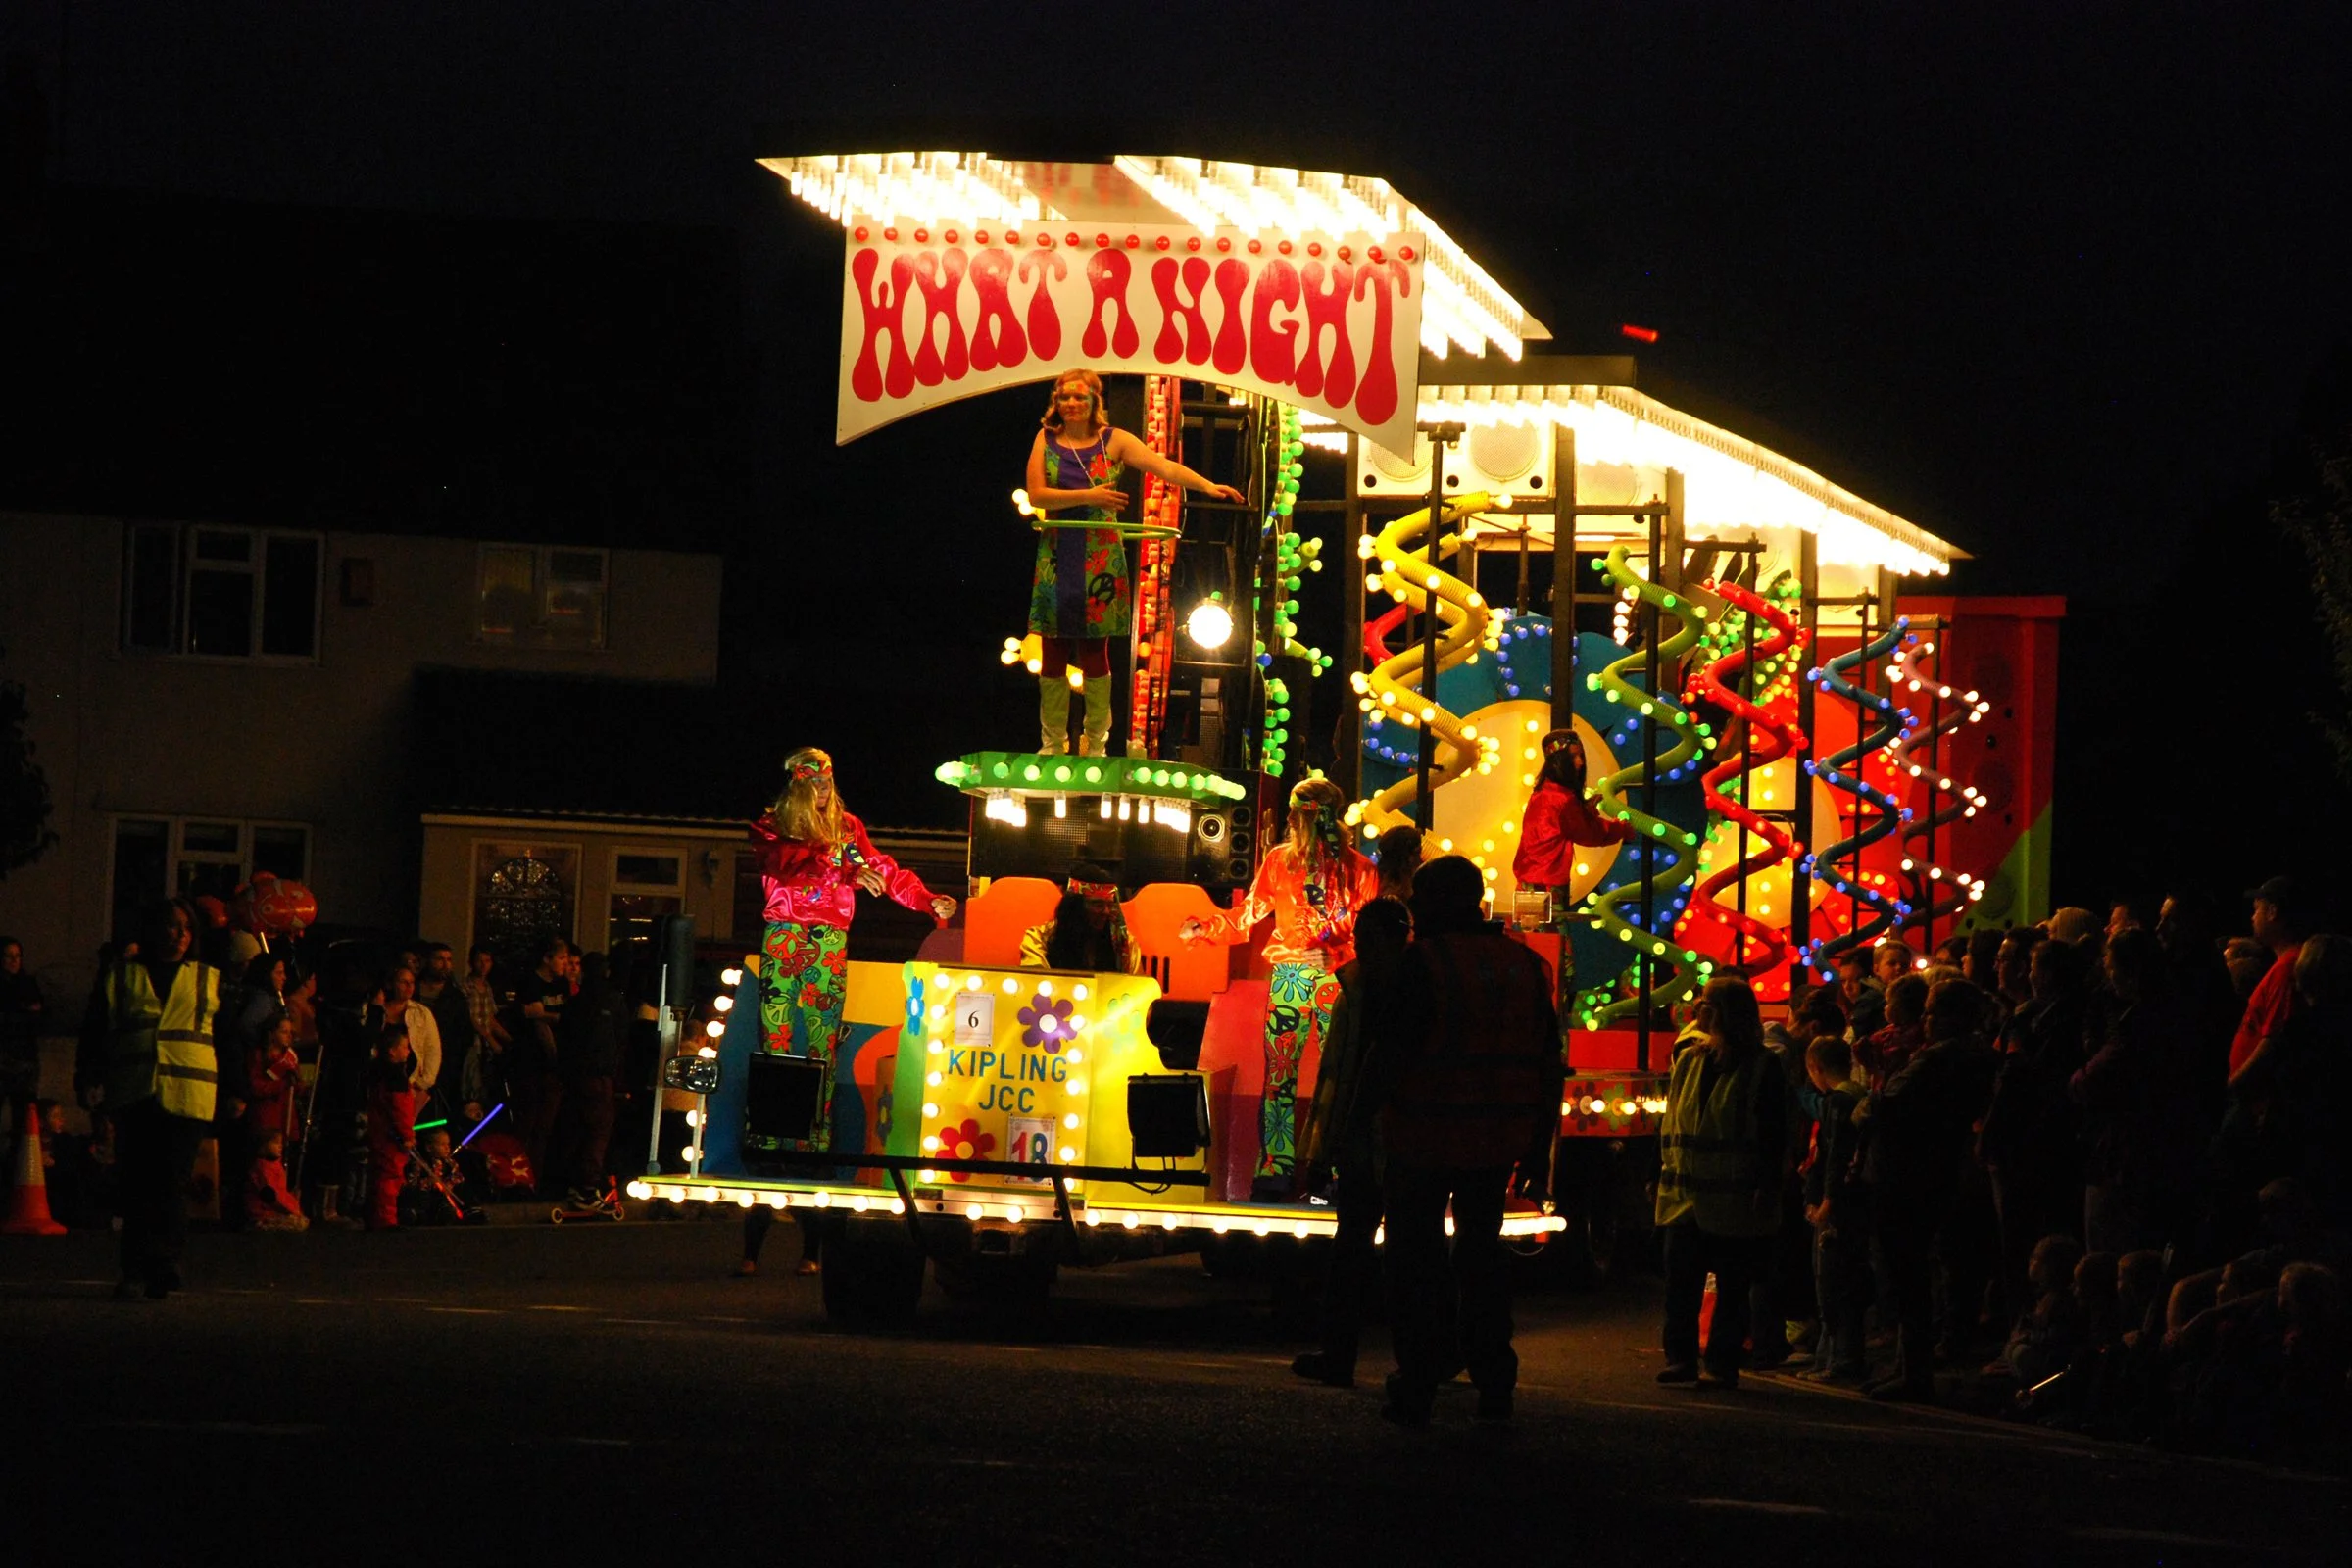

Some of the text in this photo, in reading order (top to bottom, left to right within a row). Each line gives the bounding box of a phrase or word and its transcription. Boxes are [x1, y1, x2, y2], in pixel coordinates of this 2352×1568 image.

[852, 248, 1411, 426] WHAT A NIGHT
[967, 1009, 980, 1029] 6
[948, 1049, 1067, 1083] KIPLING
[978, 1084, 1035, 1114] JCC
[1011, 1131, 1048, 1182] 18
